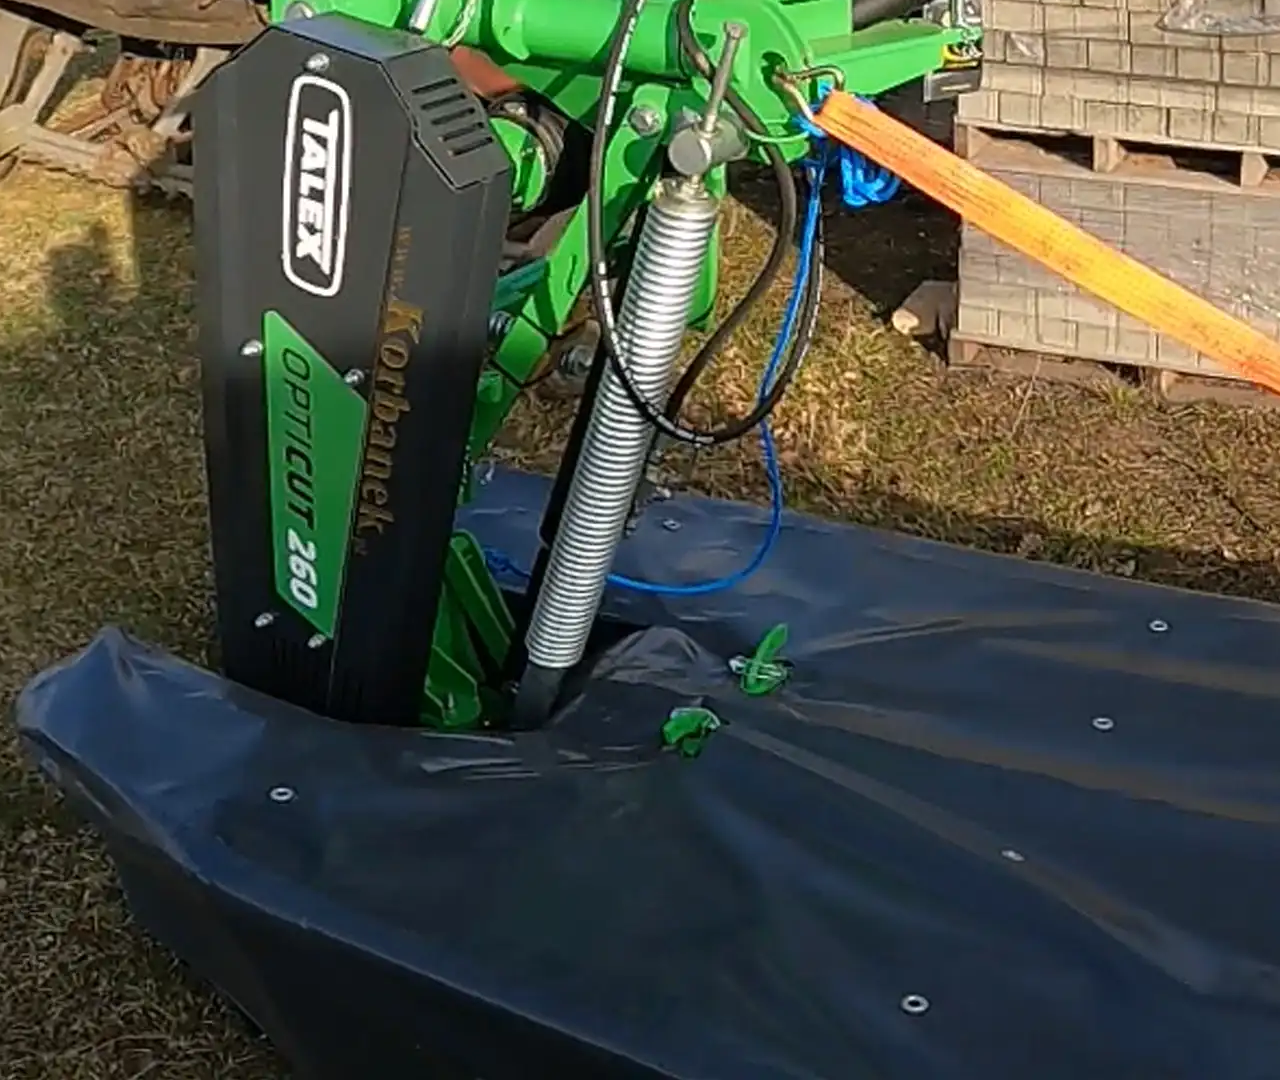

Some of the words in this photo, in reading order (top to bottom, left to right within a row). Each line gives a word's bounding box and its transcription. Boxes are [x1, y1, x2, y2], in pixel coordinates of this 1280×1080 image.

[295, 108, 340, 276] TALEX
[282, 347, 316, 531] OPTICUT
[287, 527, 318, 610] 260
